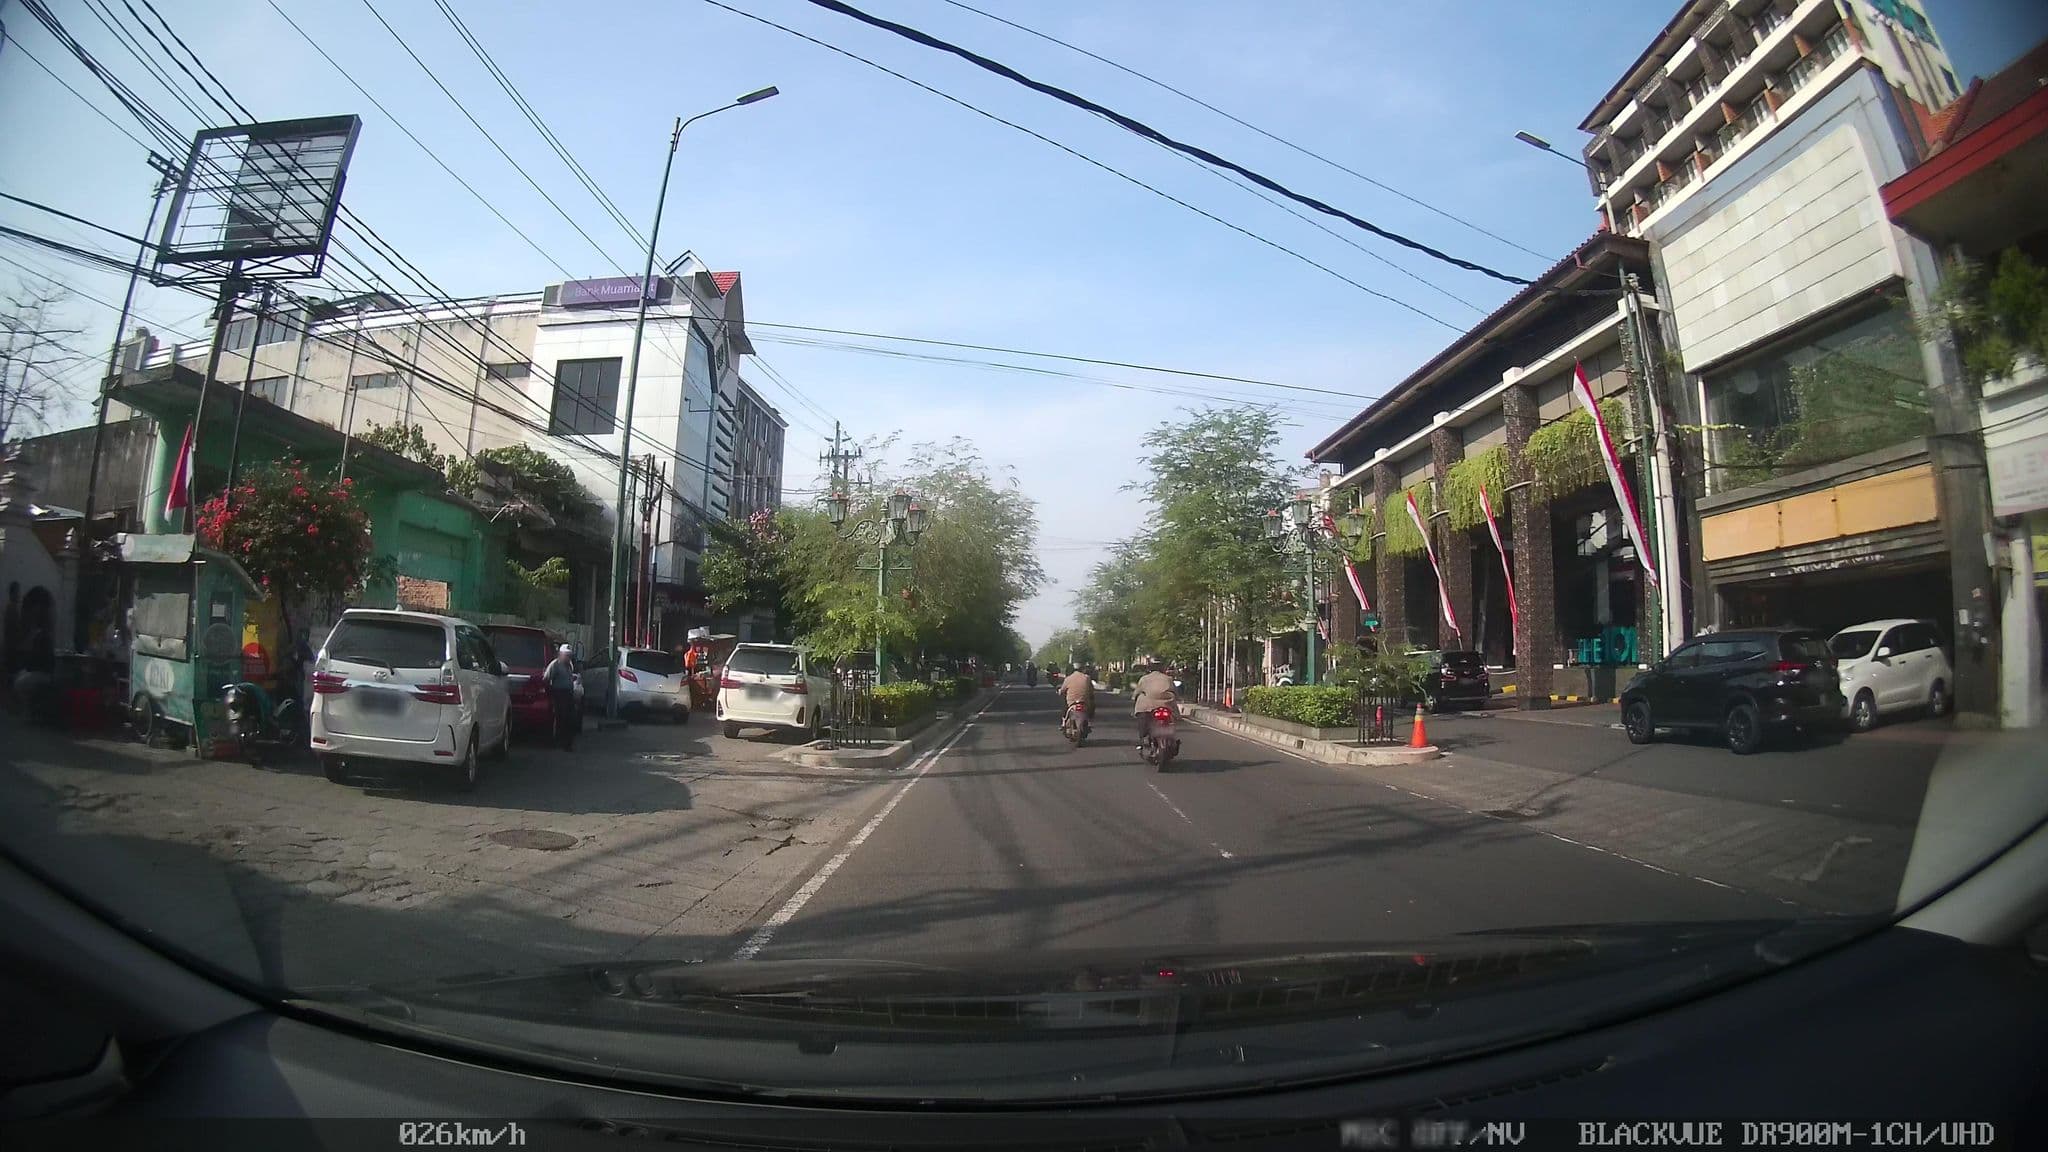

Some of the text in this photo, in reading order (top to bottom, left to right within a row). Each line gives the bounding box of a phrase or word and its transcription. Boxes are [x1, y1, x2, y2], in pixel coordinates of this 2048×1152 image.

[575, 283, 655, 297] Bank Muamat
[1577, 638, 1602, 663] THE
